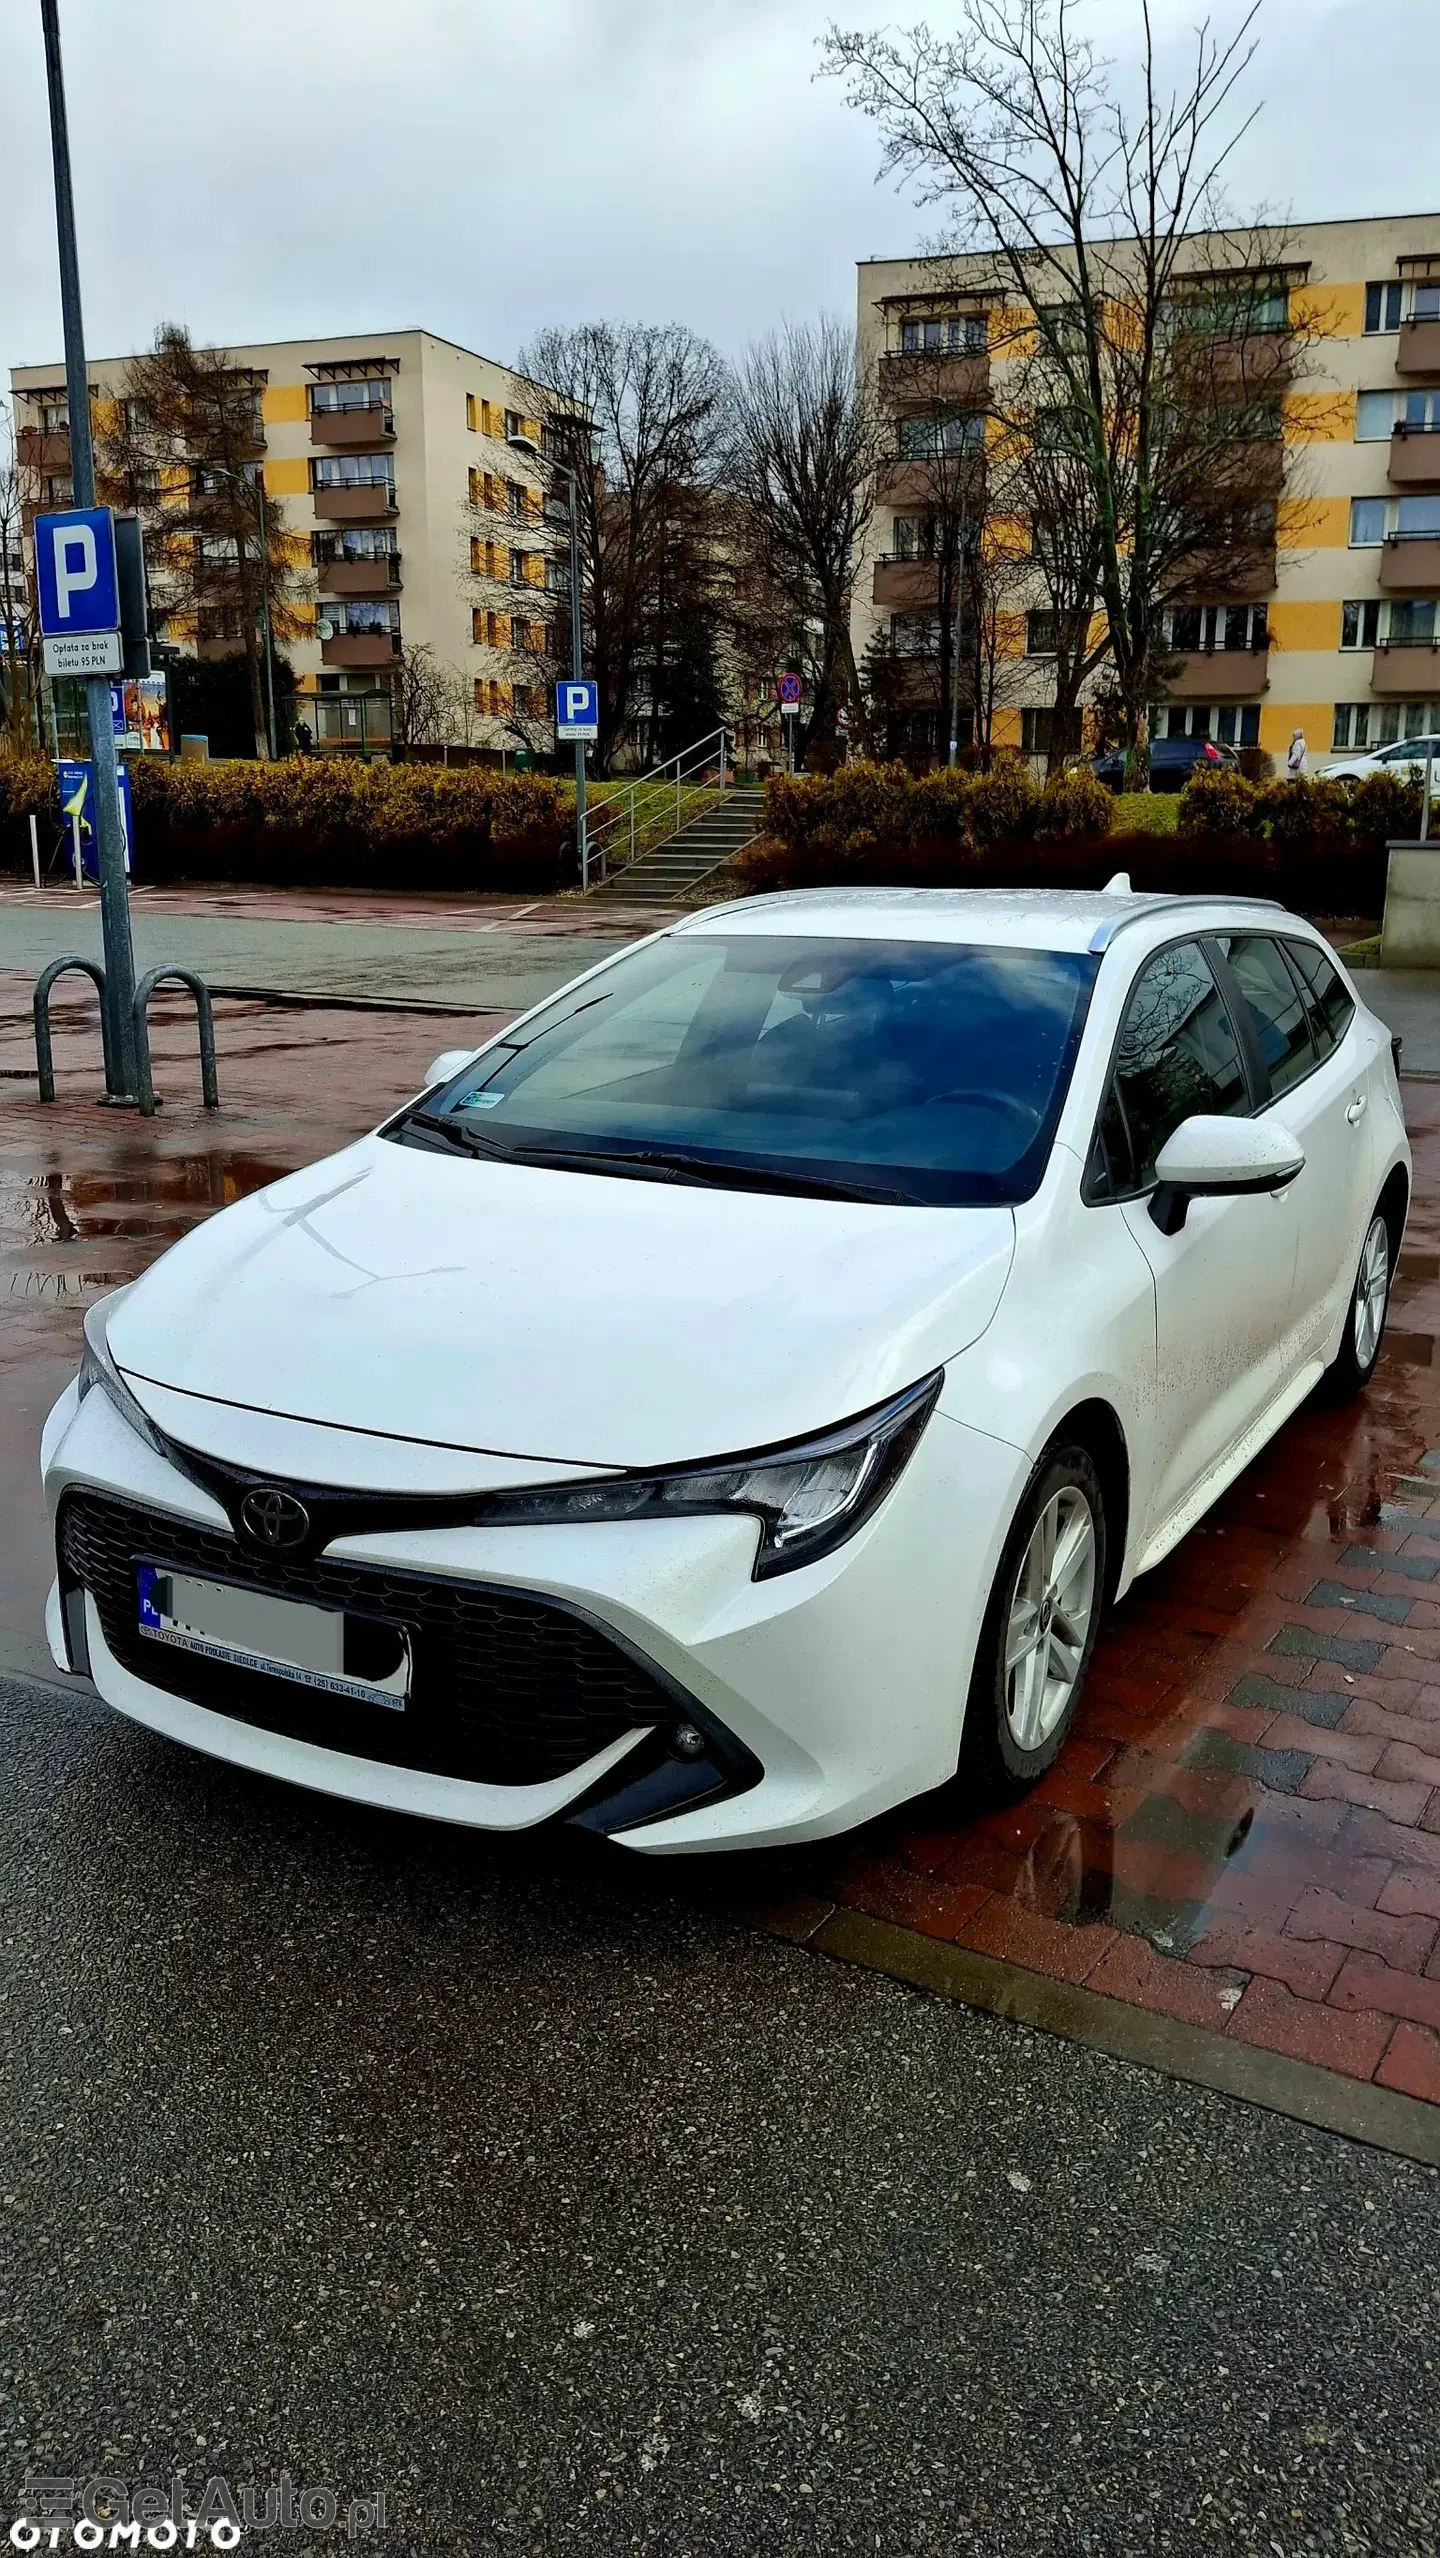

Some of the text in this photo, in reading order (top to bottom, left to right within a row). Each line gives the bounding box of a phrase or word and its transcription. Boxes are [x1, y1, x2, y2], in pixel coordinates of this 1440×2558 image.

[53, 524, 98, 618] P
[52, 643, 79, 655] Opłata
[92, 641, 109, 650] brak
[58, 656, 105, 667] biletu 95 PLN
[566, 686, 589, 719] P
[143, 1599, 158, 1616] PL
[152, 1629, 188, 1647] TOYOTA
[190, 1641, 204, 1653] AUTO
[233, 1655, 258, 1668] SIEDLCE
[314, 1677, 328, 1689] (25)
[330, 1681, 366, 1698] 633-41-10
